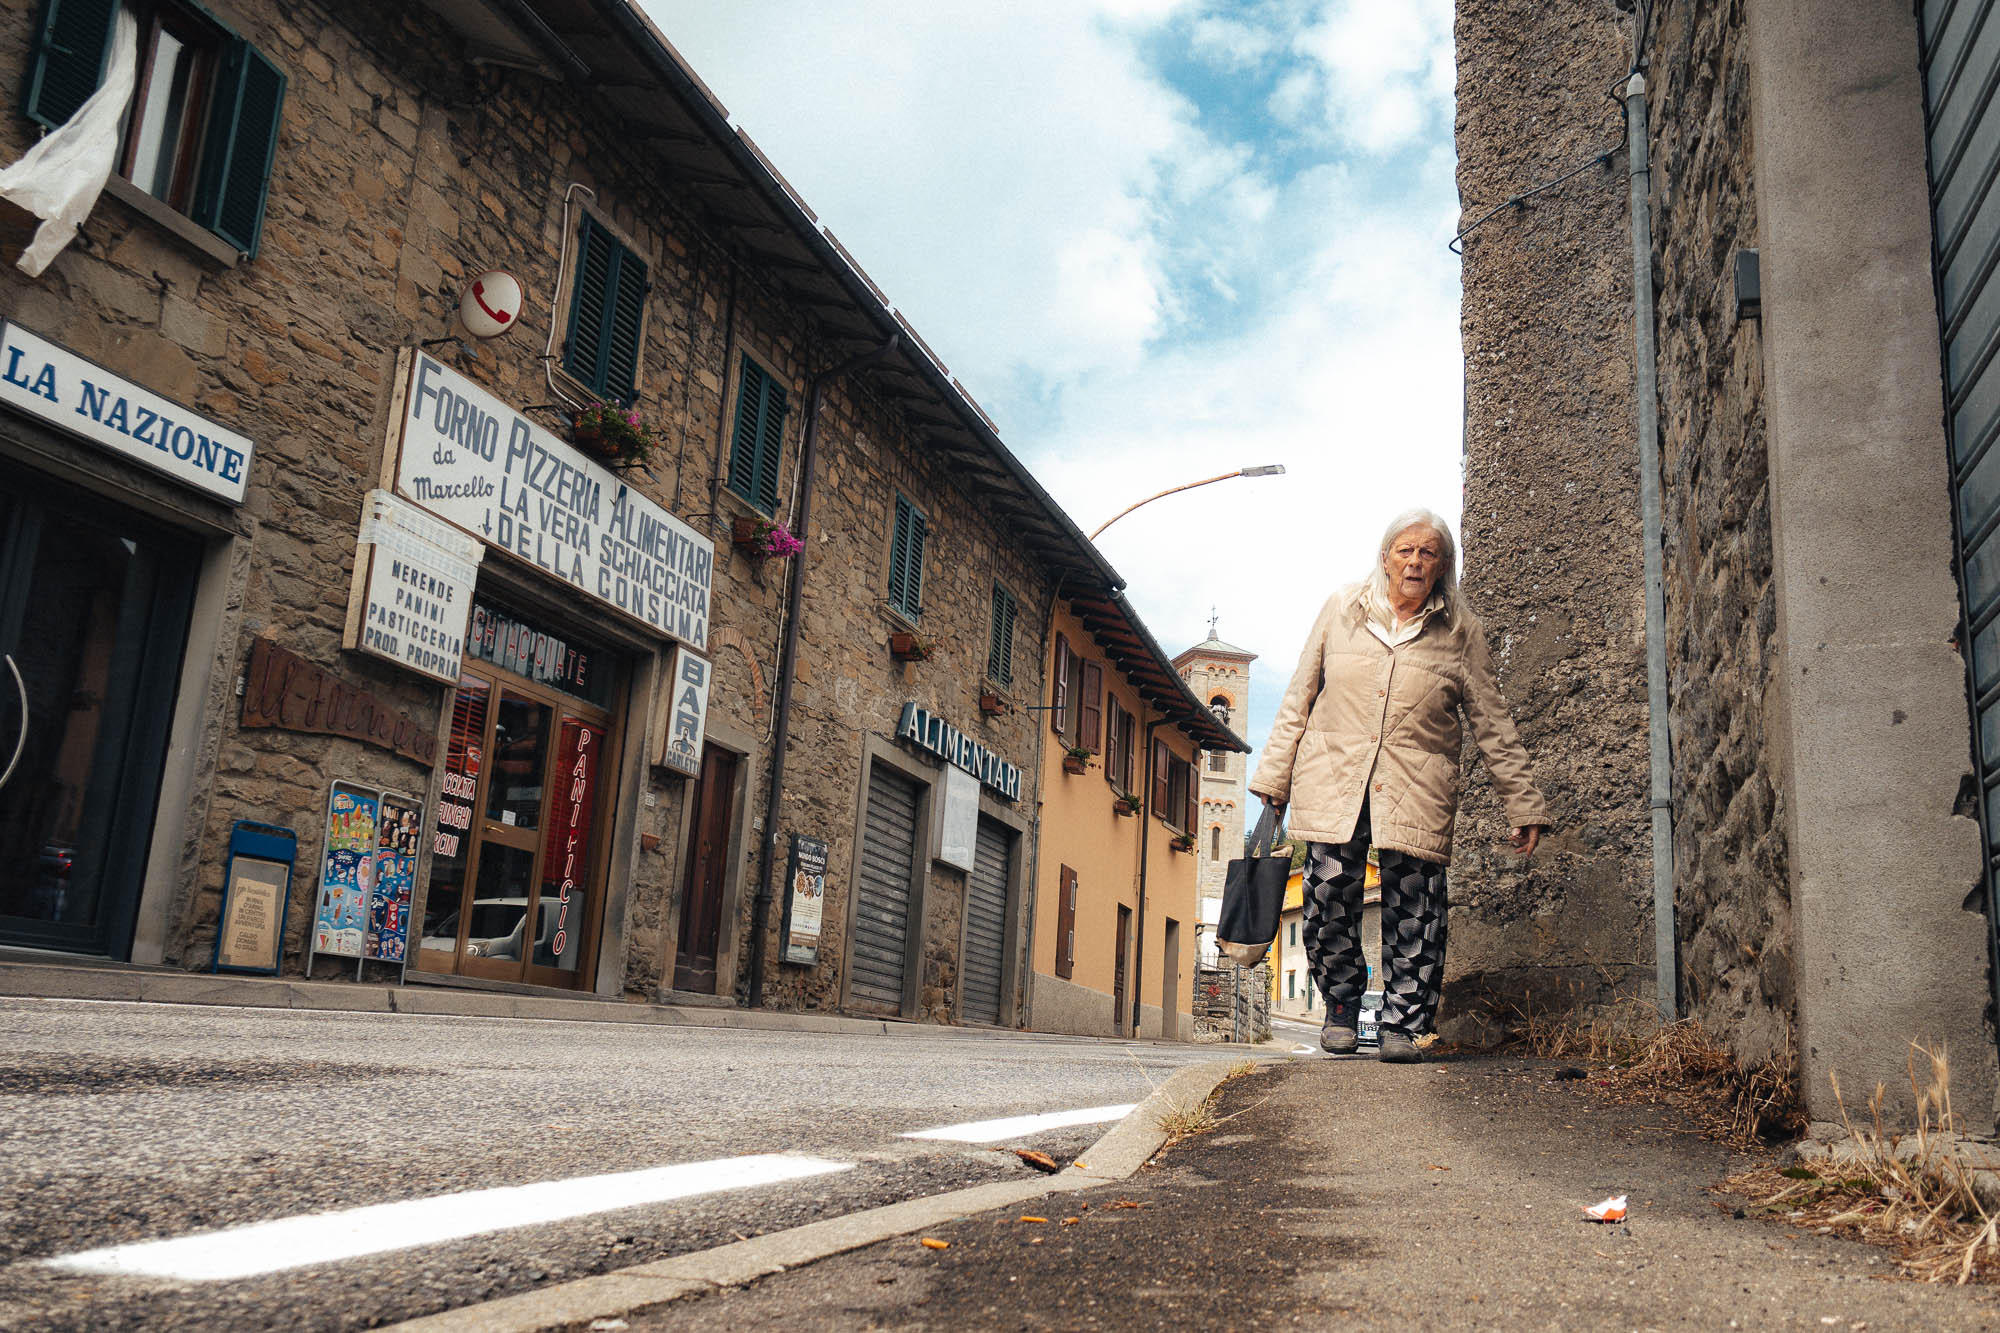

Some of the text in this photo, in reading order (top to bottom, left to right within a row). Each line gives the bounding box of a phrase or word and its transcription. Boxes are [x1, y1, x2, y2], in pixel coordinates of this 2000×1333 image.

[2, 345, 245, 485] LA NAZIONE
[412, 356, 713, 589] FORNO PIZZERIA ALIMENTARI
[412, 474, 495, 500] Marcello
[432, 442, 456, 466] da
[391, 559, 454, 603] MERENDE
[497, 511, 585, 587] DELLA
[597, 567, 706, 649] CONSUMA
[500, 476, 529, 522] LA
[539, 497, 591, 556] VERA
[600, 533, 708, 618] SCHIACCIATA
[368, 602, 460, 656] PASTICCERIA
[395, 587, 445, 625] PANINI
[364, 626, 458, 680] PROD. PROPRIA
[675, 655, 705, 742] BAR
[904, 701, 1023, 803] ALIMENTARI
